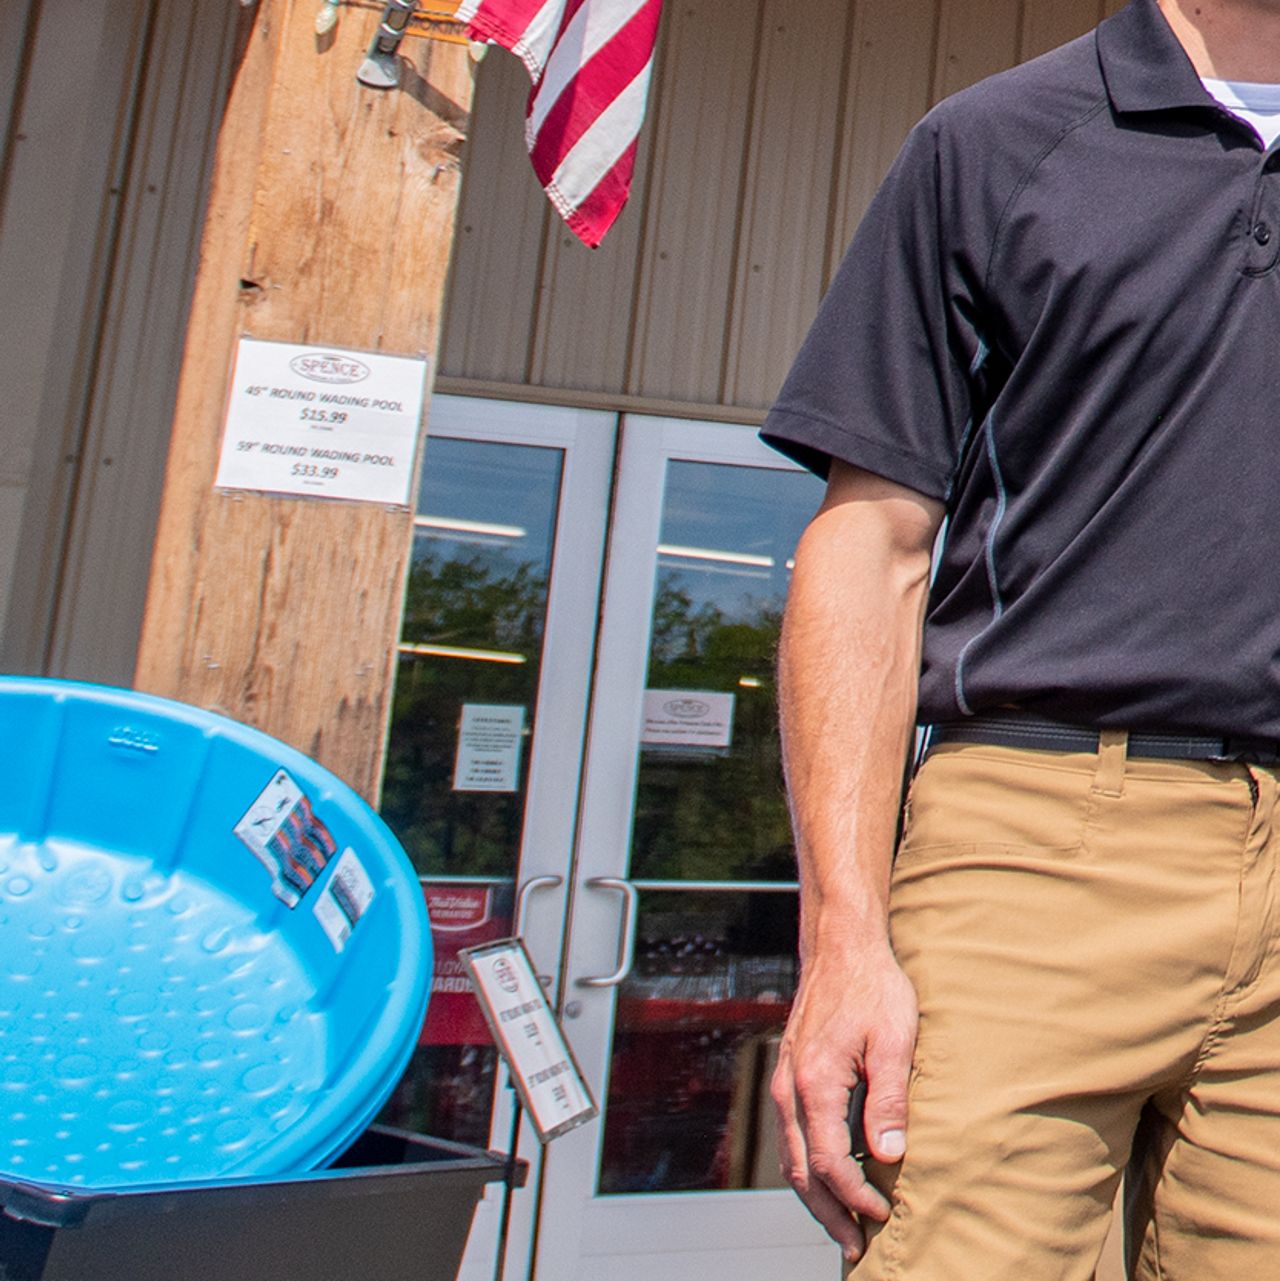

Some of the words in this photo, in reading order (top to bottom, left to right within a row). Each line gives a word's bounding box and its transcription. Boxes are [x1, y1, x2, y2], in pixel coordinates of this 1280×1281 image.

[299, 358, 359, 377] SPENCE
[269, 387, 316, 402] ROUND
[319, 392, 370, 408] WADING
[371, 400, 403, 412] POOL
[300, 407, 348, 424] $15.99
[261, 443, 307, 457] ROUND
[310, 447, 361, 463] WADING
[363, 453, 395, 466] POOL
